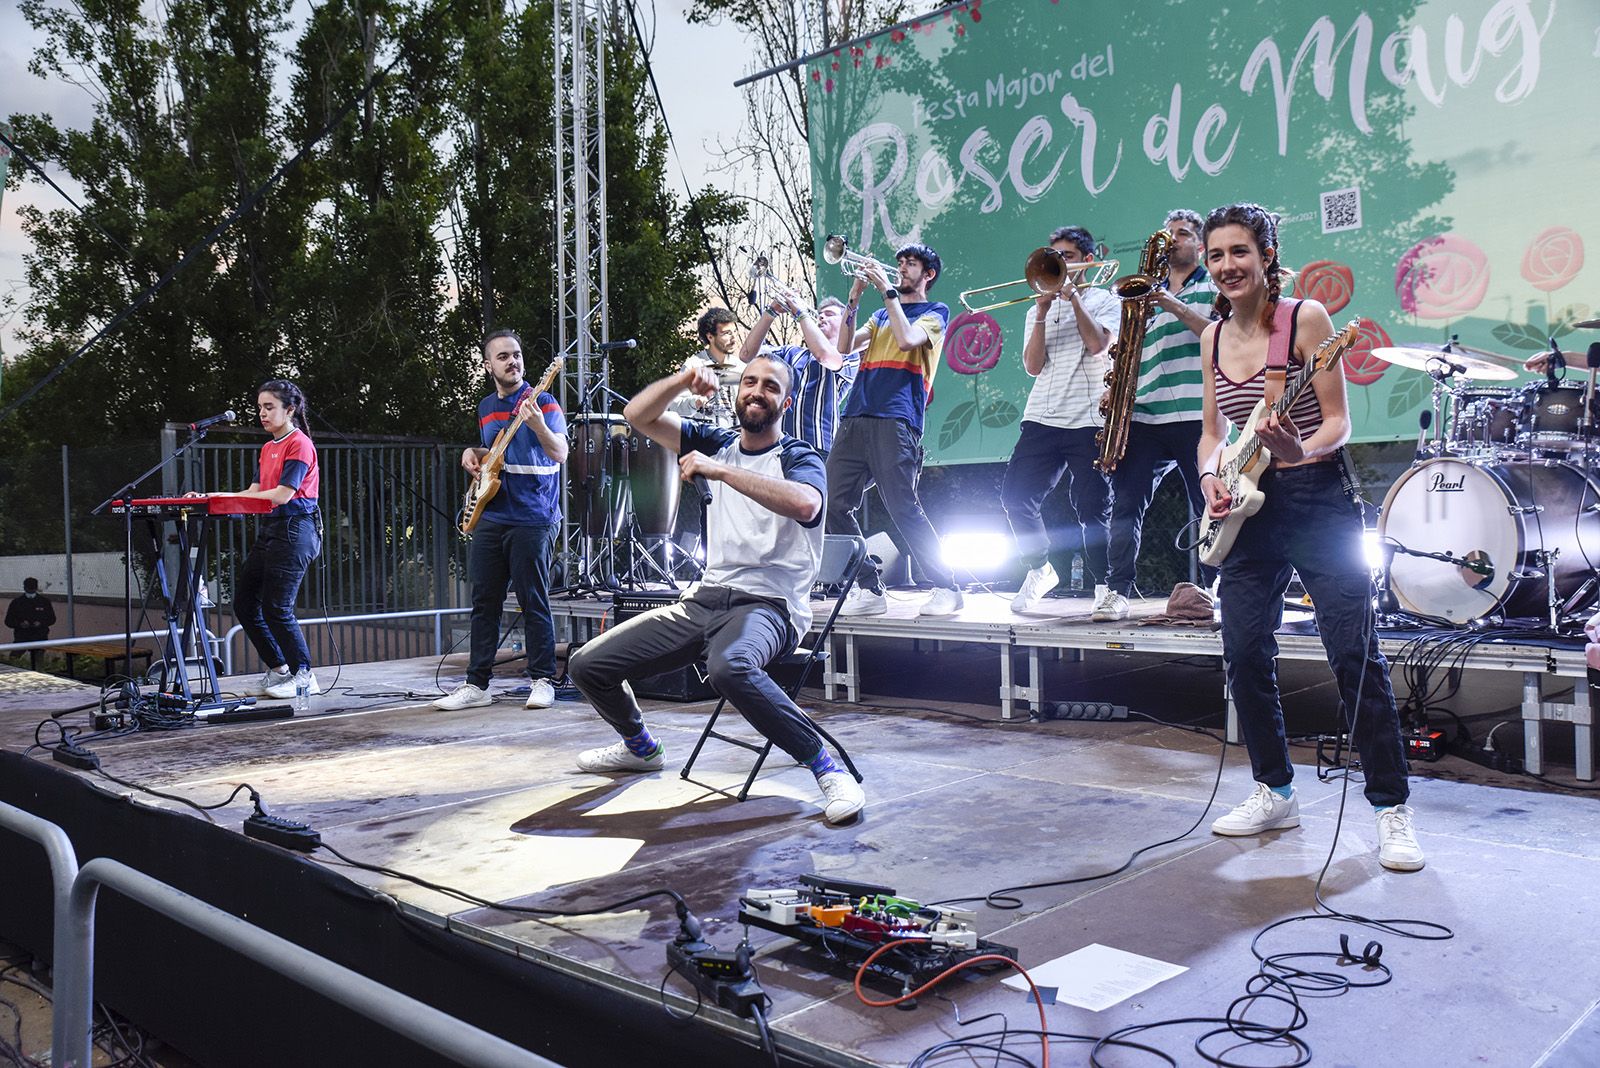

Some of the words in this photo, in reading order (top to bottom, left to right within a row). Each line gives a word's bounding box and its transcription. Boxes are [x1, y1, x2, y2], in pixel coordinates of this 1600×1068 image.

[985, 67, 1062, 110] Major
[1070, 44, 1115, 81] del
[839, 92, 1123, 252] Roser
[1143, 83, 1244, 183] de
[1239, 0, 1556, 158] Maig
[1426, 471, 1466, 492] Pearl
